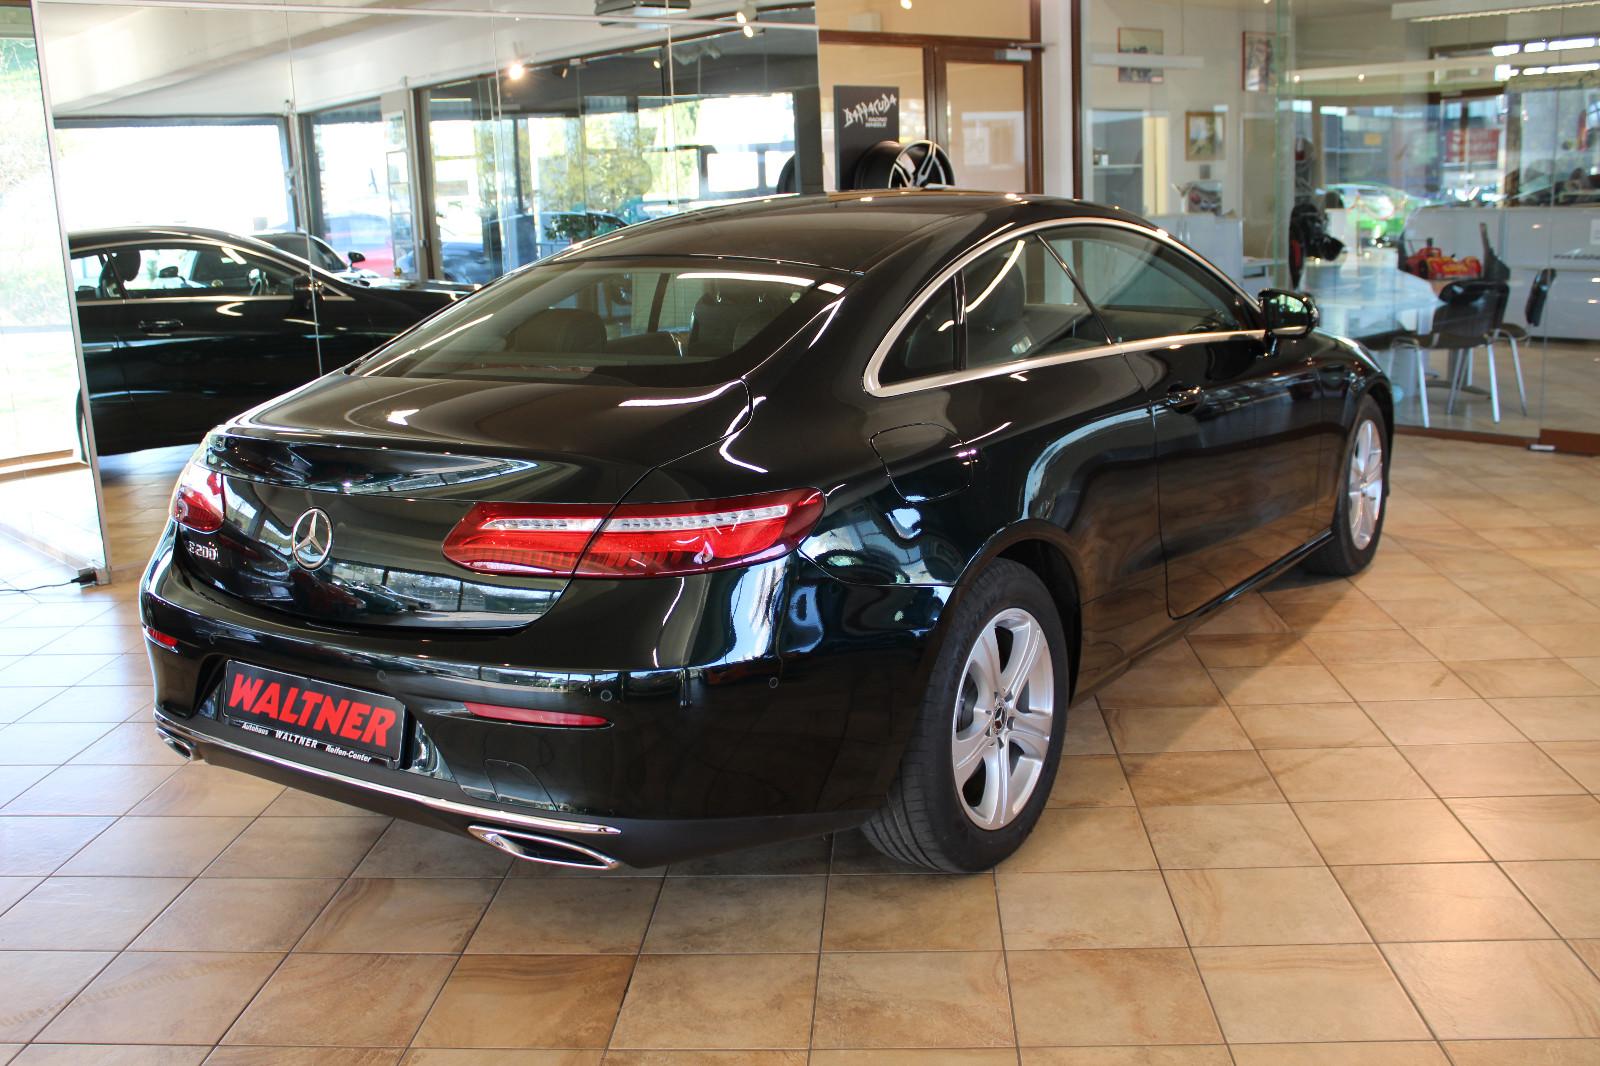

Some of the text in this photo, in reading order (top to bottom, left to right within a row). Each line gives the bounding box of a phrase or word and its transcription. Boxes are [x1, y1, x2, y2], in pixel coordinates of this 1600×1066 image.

[228, 673, 397, 747] WALTNER
[241, 722, 372, 763] Autohaus WALTNER Reifen-Center
